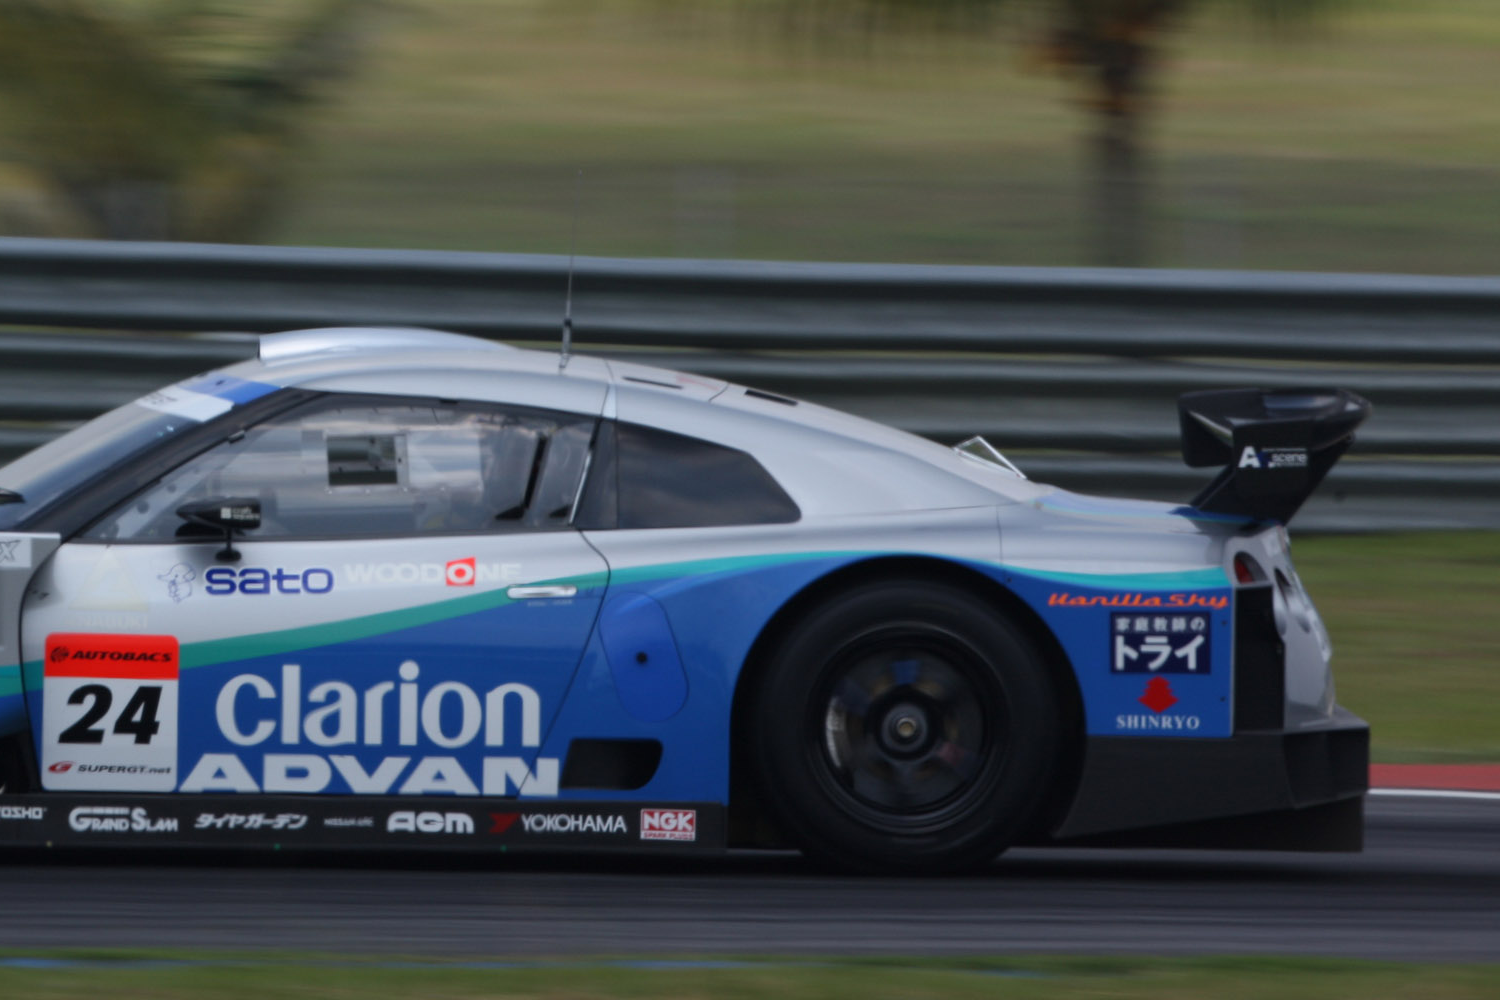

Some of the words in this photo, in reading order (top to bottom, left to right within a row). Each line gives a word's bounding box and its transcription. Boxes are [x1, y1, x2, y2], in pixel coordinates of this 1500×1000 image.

[204, 566, 334, 596] sato
[345, 559, 521, 586] WOODONE
[72, 649, 173, 663] AUTOBACS
[1115, 635, 1205, 671] トライ
[57, 683, 163, 745] 24
[215, 660, 541, 748] Clarion
[1116, 714, 1200, 730] SHINRYO
[77, 763, 172, 775] SUPERGT.net
[178, 753, 560, 797] ADVAN
[521, 813, 627, 833] YOKOHAMA
[642, 812, 694, 831] NGK
